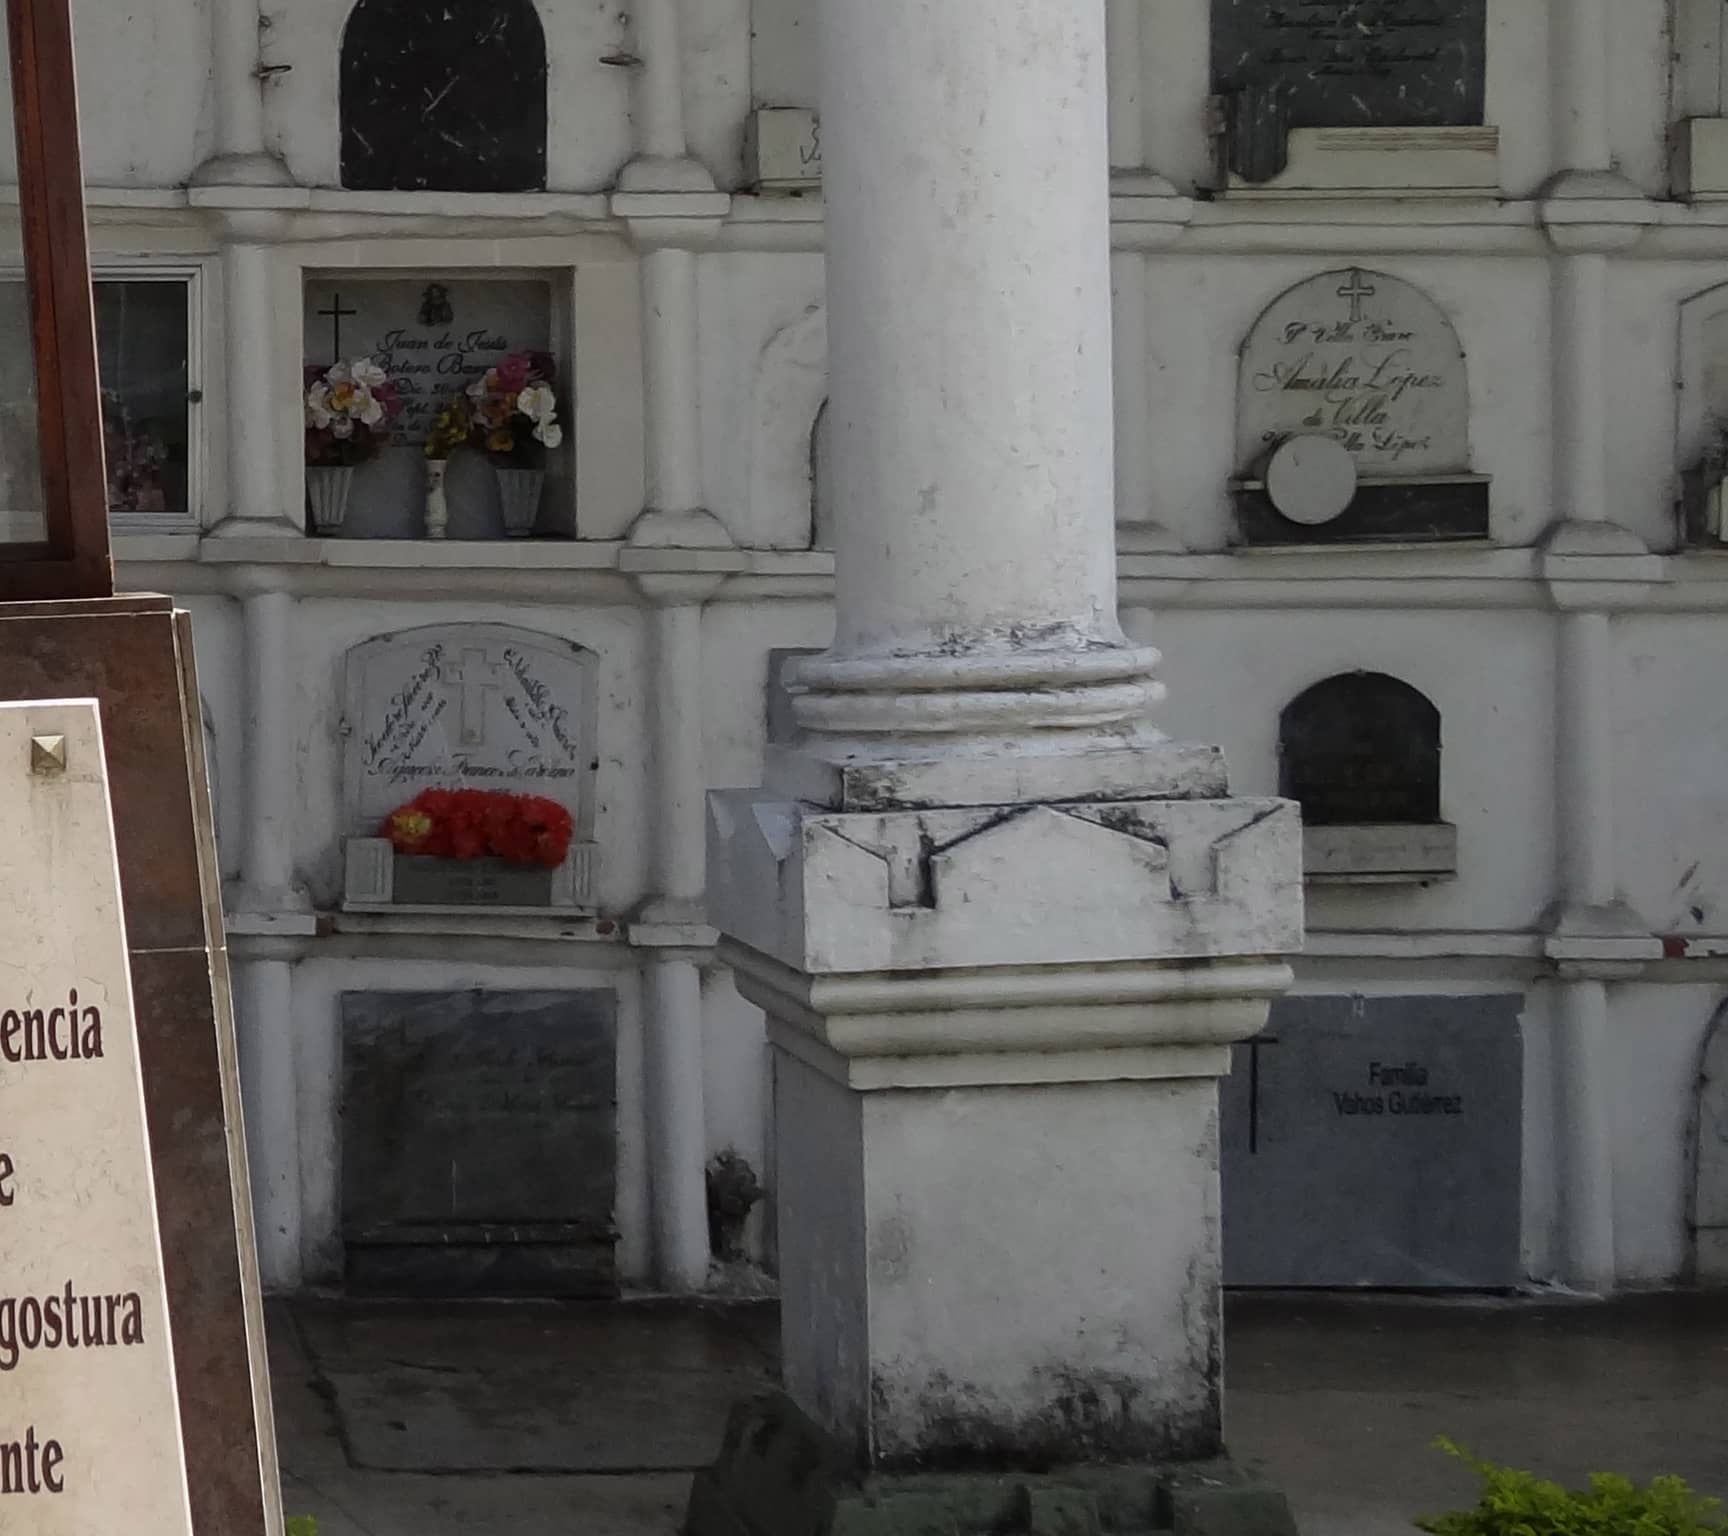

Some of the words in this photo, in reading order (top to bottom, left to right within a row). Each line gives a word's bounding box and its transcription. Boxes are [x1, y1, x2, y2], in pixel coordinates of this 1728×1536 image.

[376, 329, 429, 353] Juan
[433, 331, 454, 351] de
[1368, 1061, 1429, 1086] Familia
